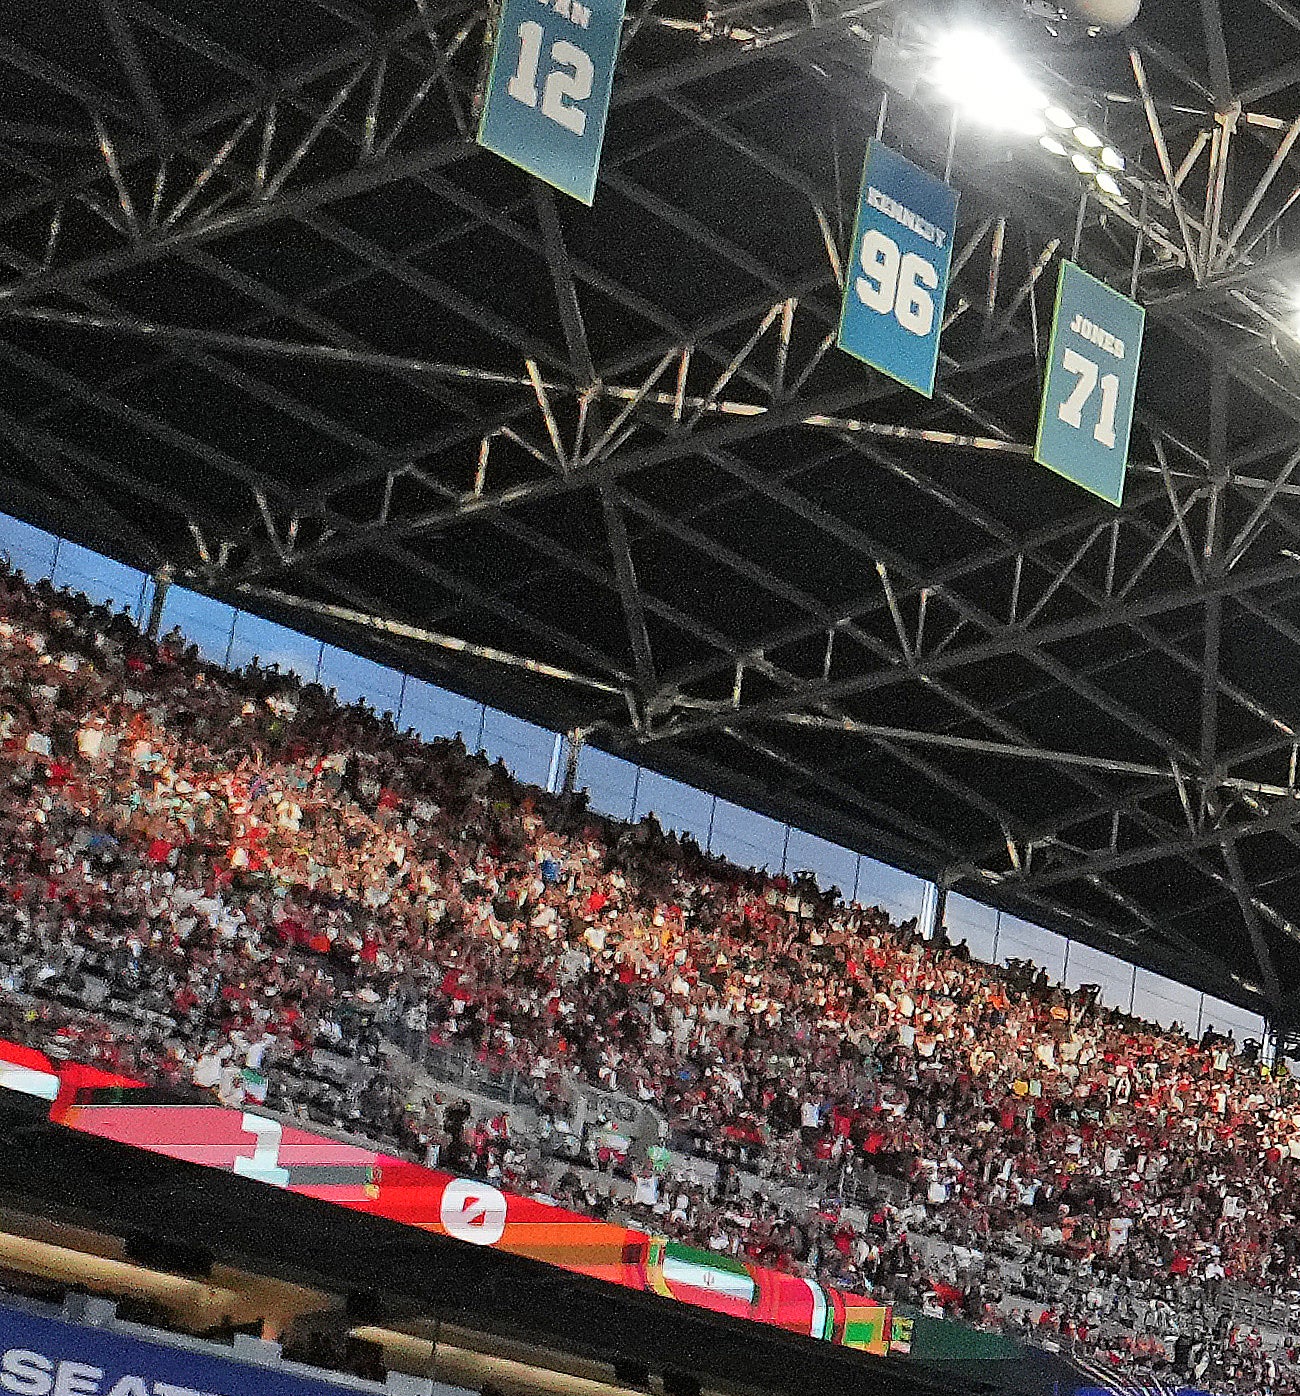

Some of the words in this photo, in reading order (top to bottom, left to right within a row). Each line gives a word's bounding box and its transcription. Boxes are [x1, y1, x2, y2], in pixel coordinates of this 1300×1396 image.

[507, 20, 595, 137] 12
[855, 229, 938, 337] 96
[1058, 348, 1120, 449] 71
[233, 1111, 290, 1188] 1
[440, 1177, 518, 1246] 0
